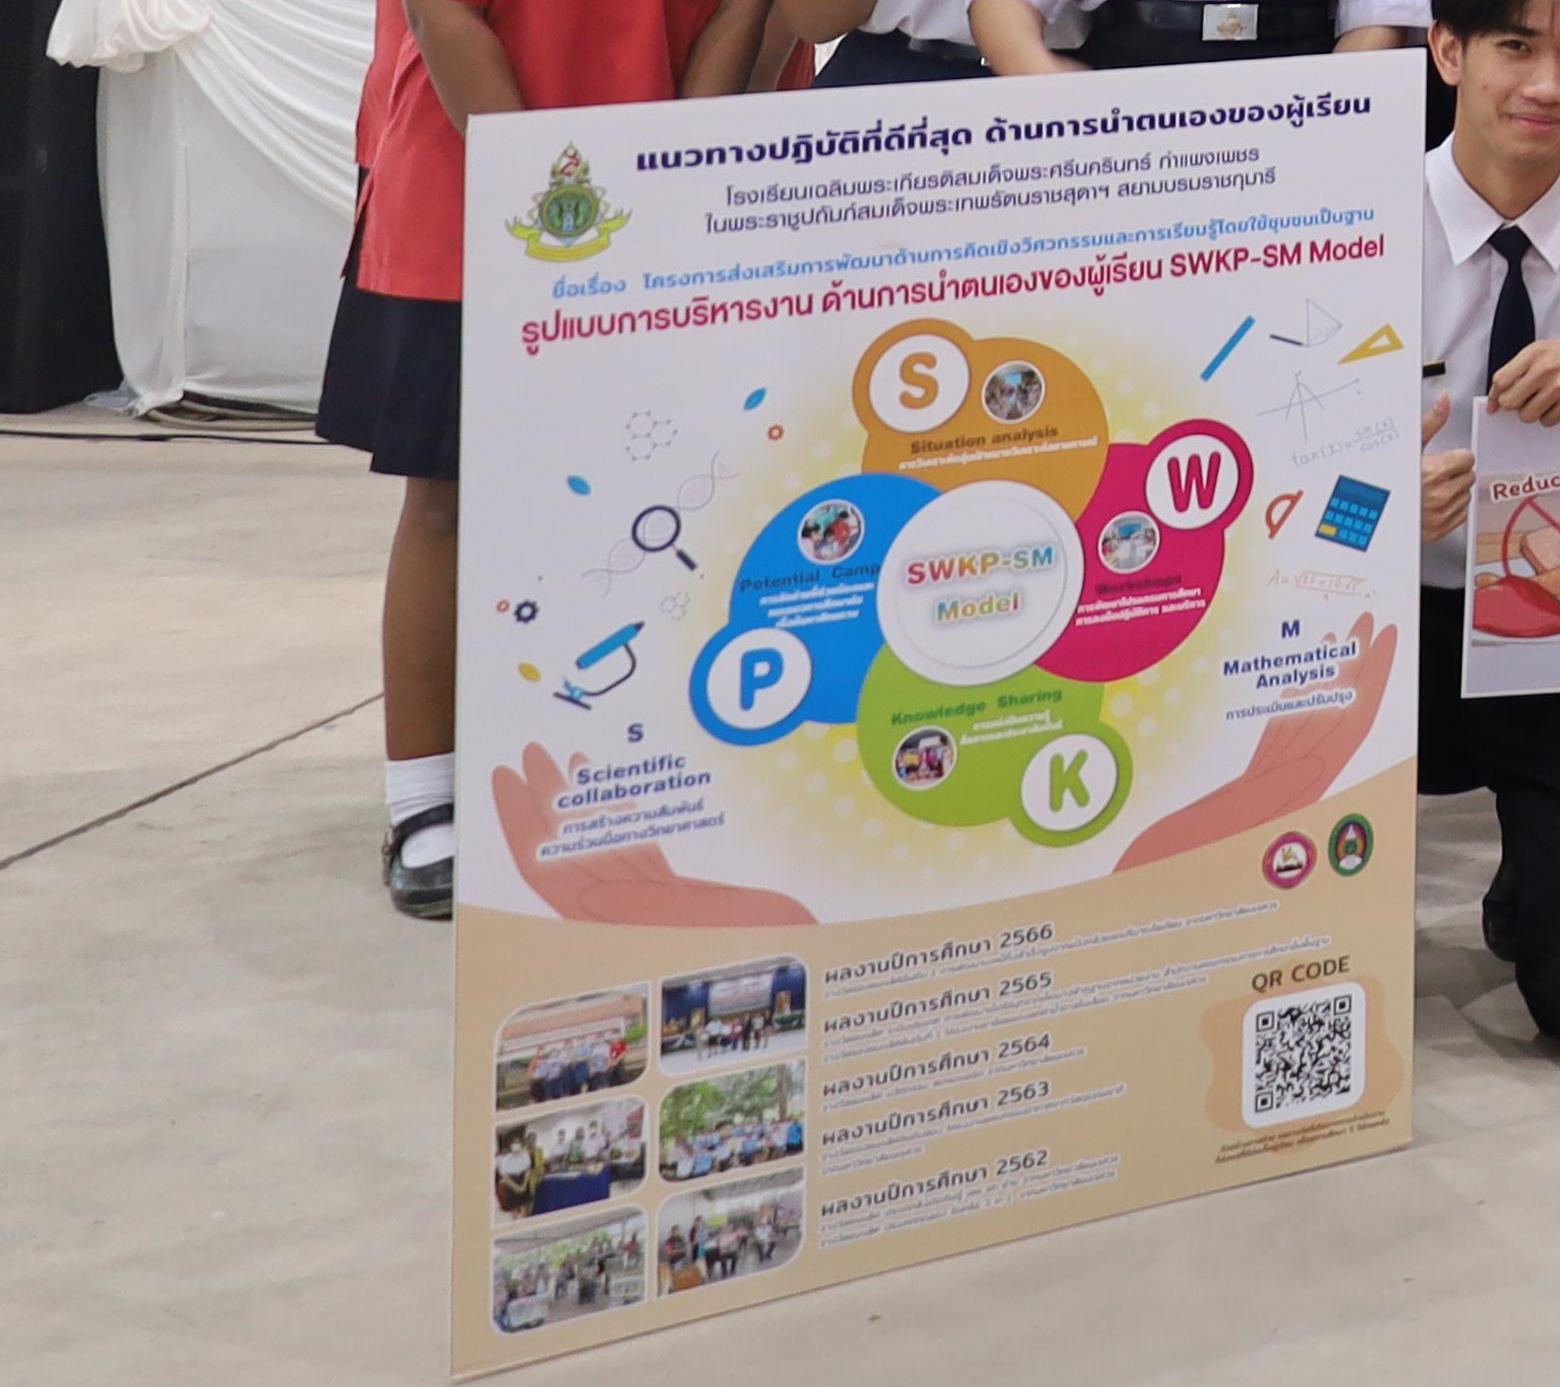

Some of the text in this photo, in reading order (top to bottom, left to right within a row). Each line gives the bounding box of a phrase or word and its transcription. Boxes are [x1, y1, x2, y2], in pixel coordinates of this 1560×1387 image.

[636, 91, 1371, 171] แนวทางปฏิบัติที่ดีที่สุด ด้านการนำตนเองของผู้เรียน
[705, 167, 1276, 234] ในพระราชูปถัมภ์สมเด็จพระเทพรัตนราชสุดาฯ สยามบรมราชกุมารี
[726, 148, 1260, 207] โรงเรียนเฉลิมพระเกียรติสมเด็จพระศรีนครินทร์ กำแพงเพชร
[521, 234, 1385, 356] รูปแบบการบริหารงาน ด้านการนำตนเองของผู้เรียน SWKP-SM Model
[552, 272, 627, 299] ชื่อเรื่อง
[899, 352, 939, 409] S
[911, 426, 1059, 454] Situation analysis
[1167, 451, 1221, 512] W
[740, 570, 820, 592] Potential
[906, 544, 1055, 586] SWKP-SM
[936, 591, 1020, 623] Model
[1281, 619, 1300, 639] M
[739, 647, 784, 711] P
[1223, 641, 1356, 676] Mathematical
[1256, 664, 1336, 690] Analysis
[891, 689, 1063, 725] Knowledge Sharing
[627, 723, 644, 744] S
[557, 770, 712, 809] collaboration
[577, 753, 687, 785] Scientific
[1049, 749, 1090, 812] K
[824, 924, 1053, 984] ผลงานปีการศึกษา 2566
[1251, 955, 1351, 994] QR CODE
[824, 987, 990, 1033] ผลงานปีการศึกษา
[999, 972, 1052, 997] 2565
[823, 1049, 989, 1097] ผลงานปีการศึกษา
[998, 1034, 1051, 1059] 2564
[822, 1096, 988, 1145] ผลงานปีการศึกษา
[997, 1081, 1050, 1106] 2563
[821, 1165, 987, 1217] ผลงานปีการศึกษา
[996, 1150, 1048, 1176] 2562
